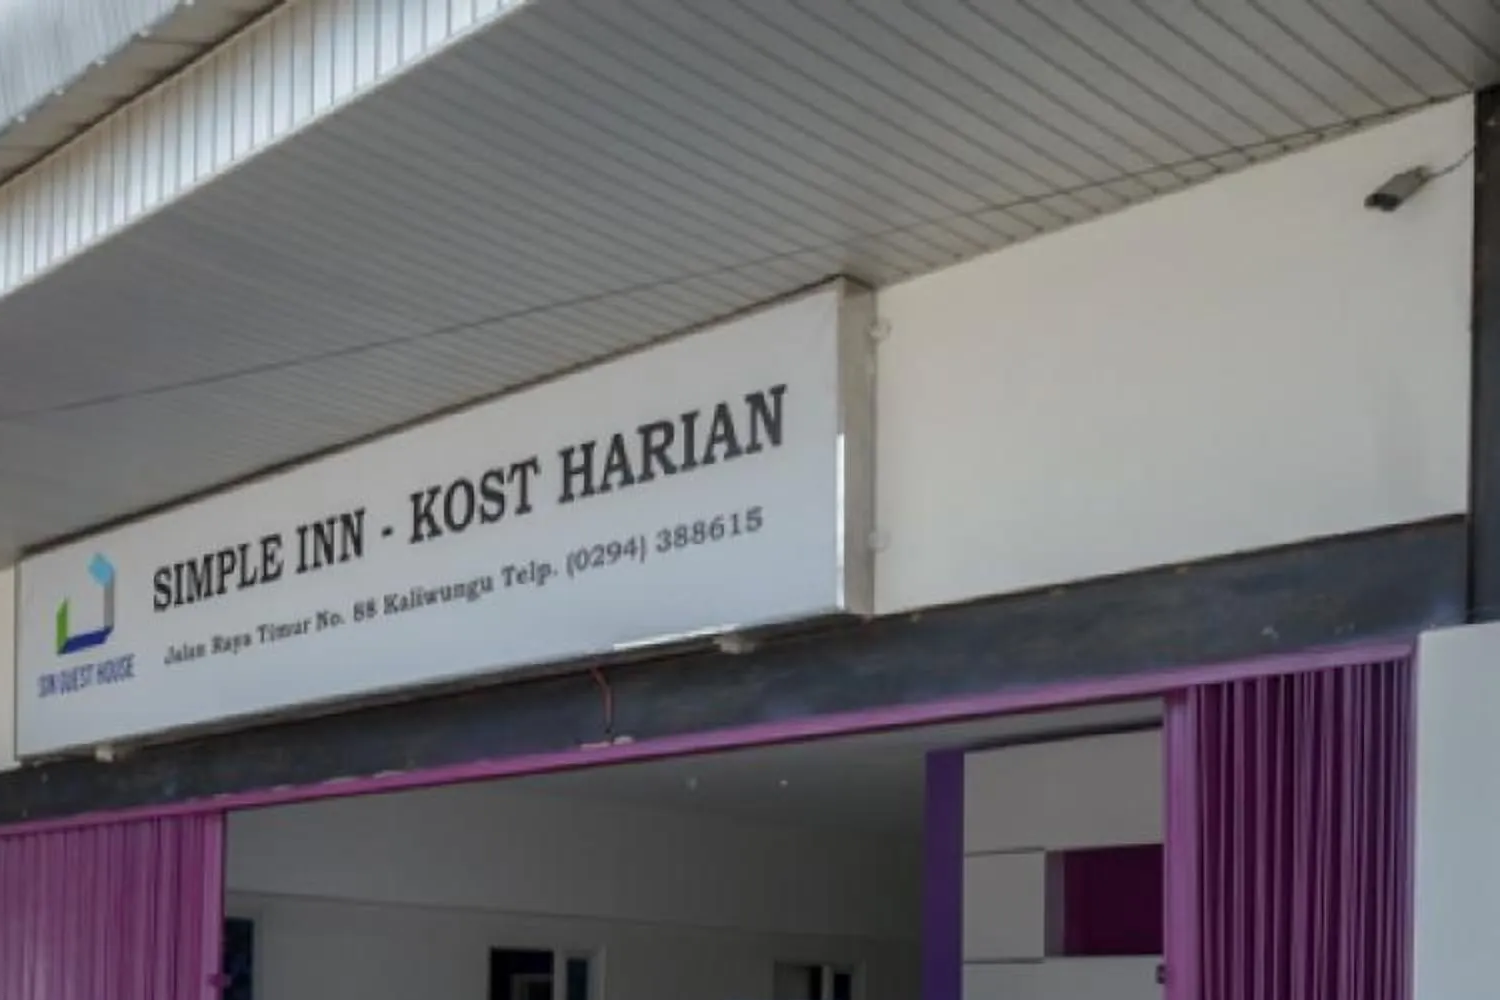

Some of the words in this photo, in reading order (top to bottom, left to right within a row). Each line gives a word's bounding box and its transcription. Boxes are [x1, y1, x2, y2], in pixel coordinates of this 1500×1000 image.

[153, 532, 284, 613] SIMPLE
[295, 507, 366, 574] INN
[409, 455, 541, 544] KOST
[557, 383, 787, 504] HARIAN
[163, 643, 206, 665] Jalan
[210, 634, 252, 655] Raya
[256, 618, 311, 644] Timur
[315, 608, 345, 632] No.
[383, 575, 494, 615] Kaliwungu
[501, 560, 558, 587] Telp.
[566, 535, 645, 578] (0294)
[656, 505, 763, 553] 388615
[96, 652, 135, 685] HOUSE
